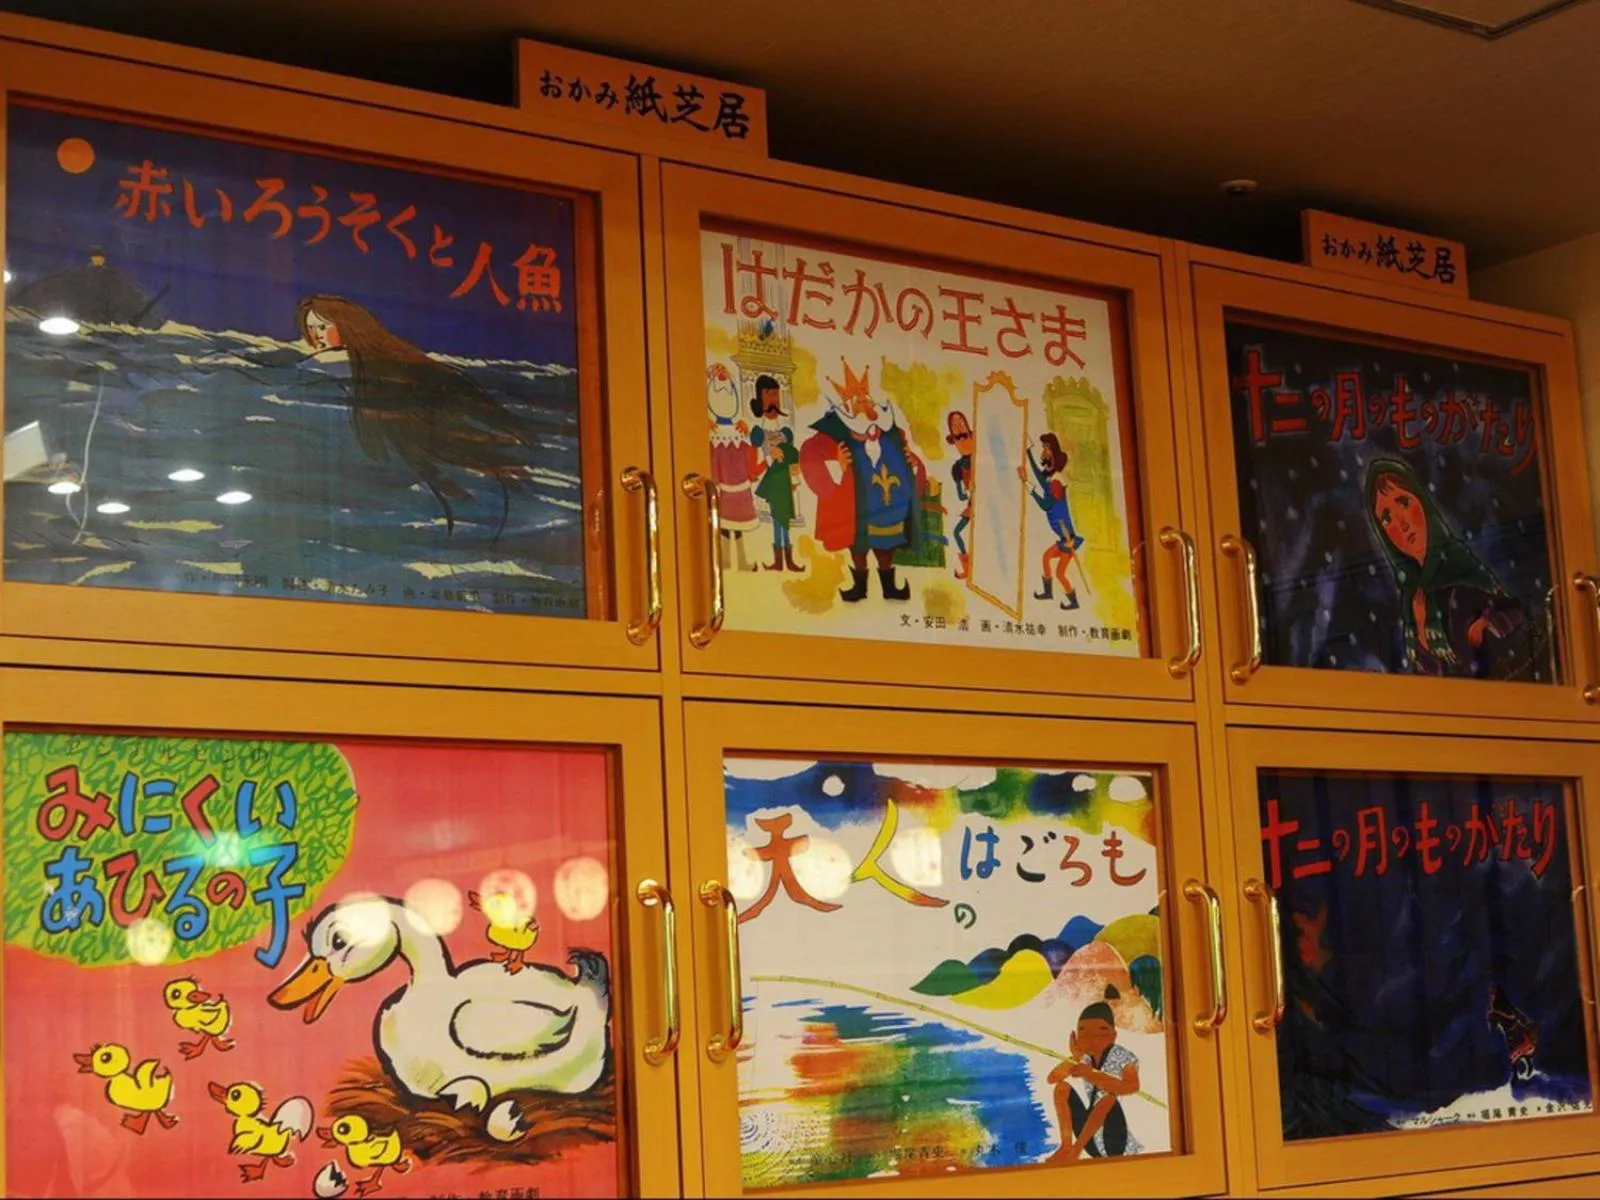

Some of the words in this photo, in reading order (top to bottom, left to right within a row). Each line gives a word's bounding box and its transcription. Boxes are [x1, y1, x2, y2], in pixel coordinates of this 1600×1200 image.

[539, 69, 750, 140] おかみ紙芝居
[116, 159, 563, 314] 赤いろうそくと人魚
[1321, 233, 1457, 285] おかみ紙芝居
[719, 242, 1088, 370] はだかの王さま
[36, 764, 298, 842] みにくい
[1260, 799, 1558, 890] 十二の月のものがたり
[40, 842, 306, 969] あひるの子
